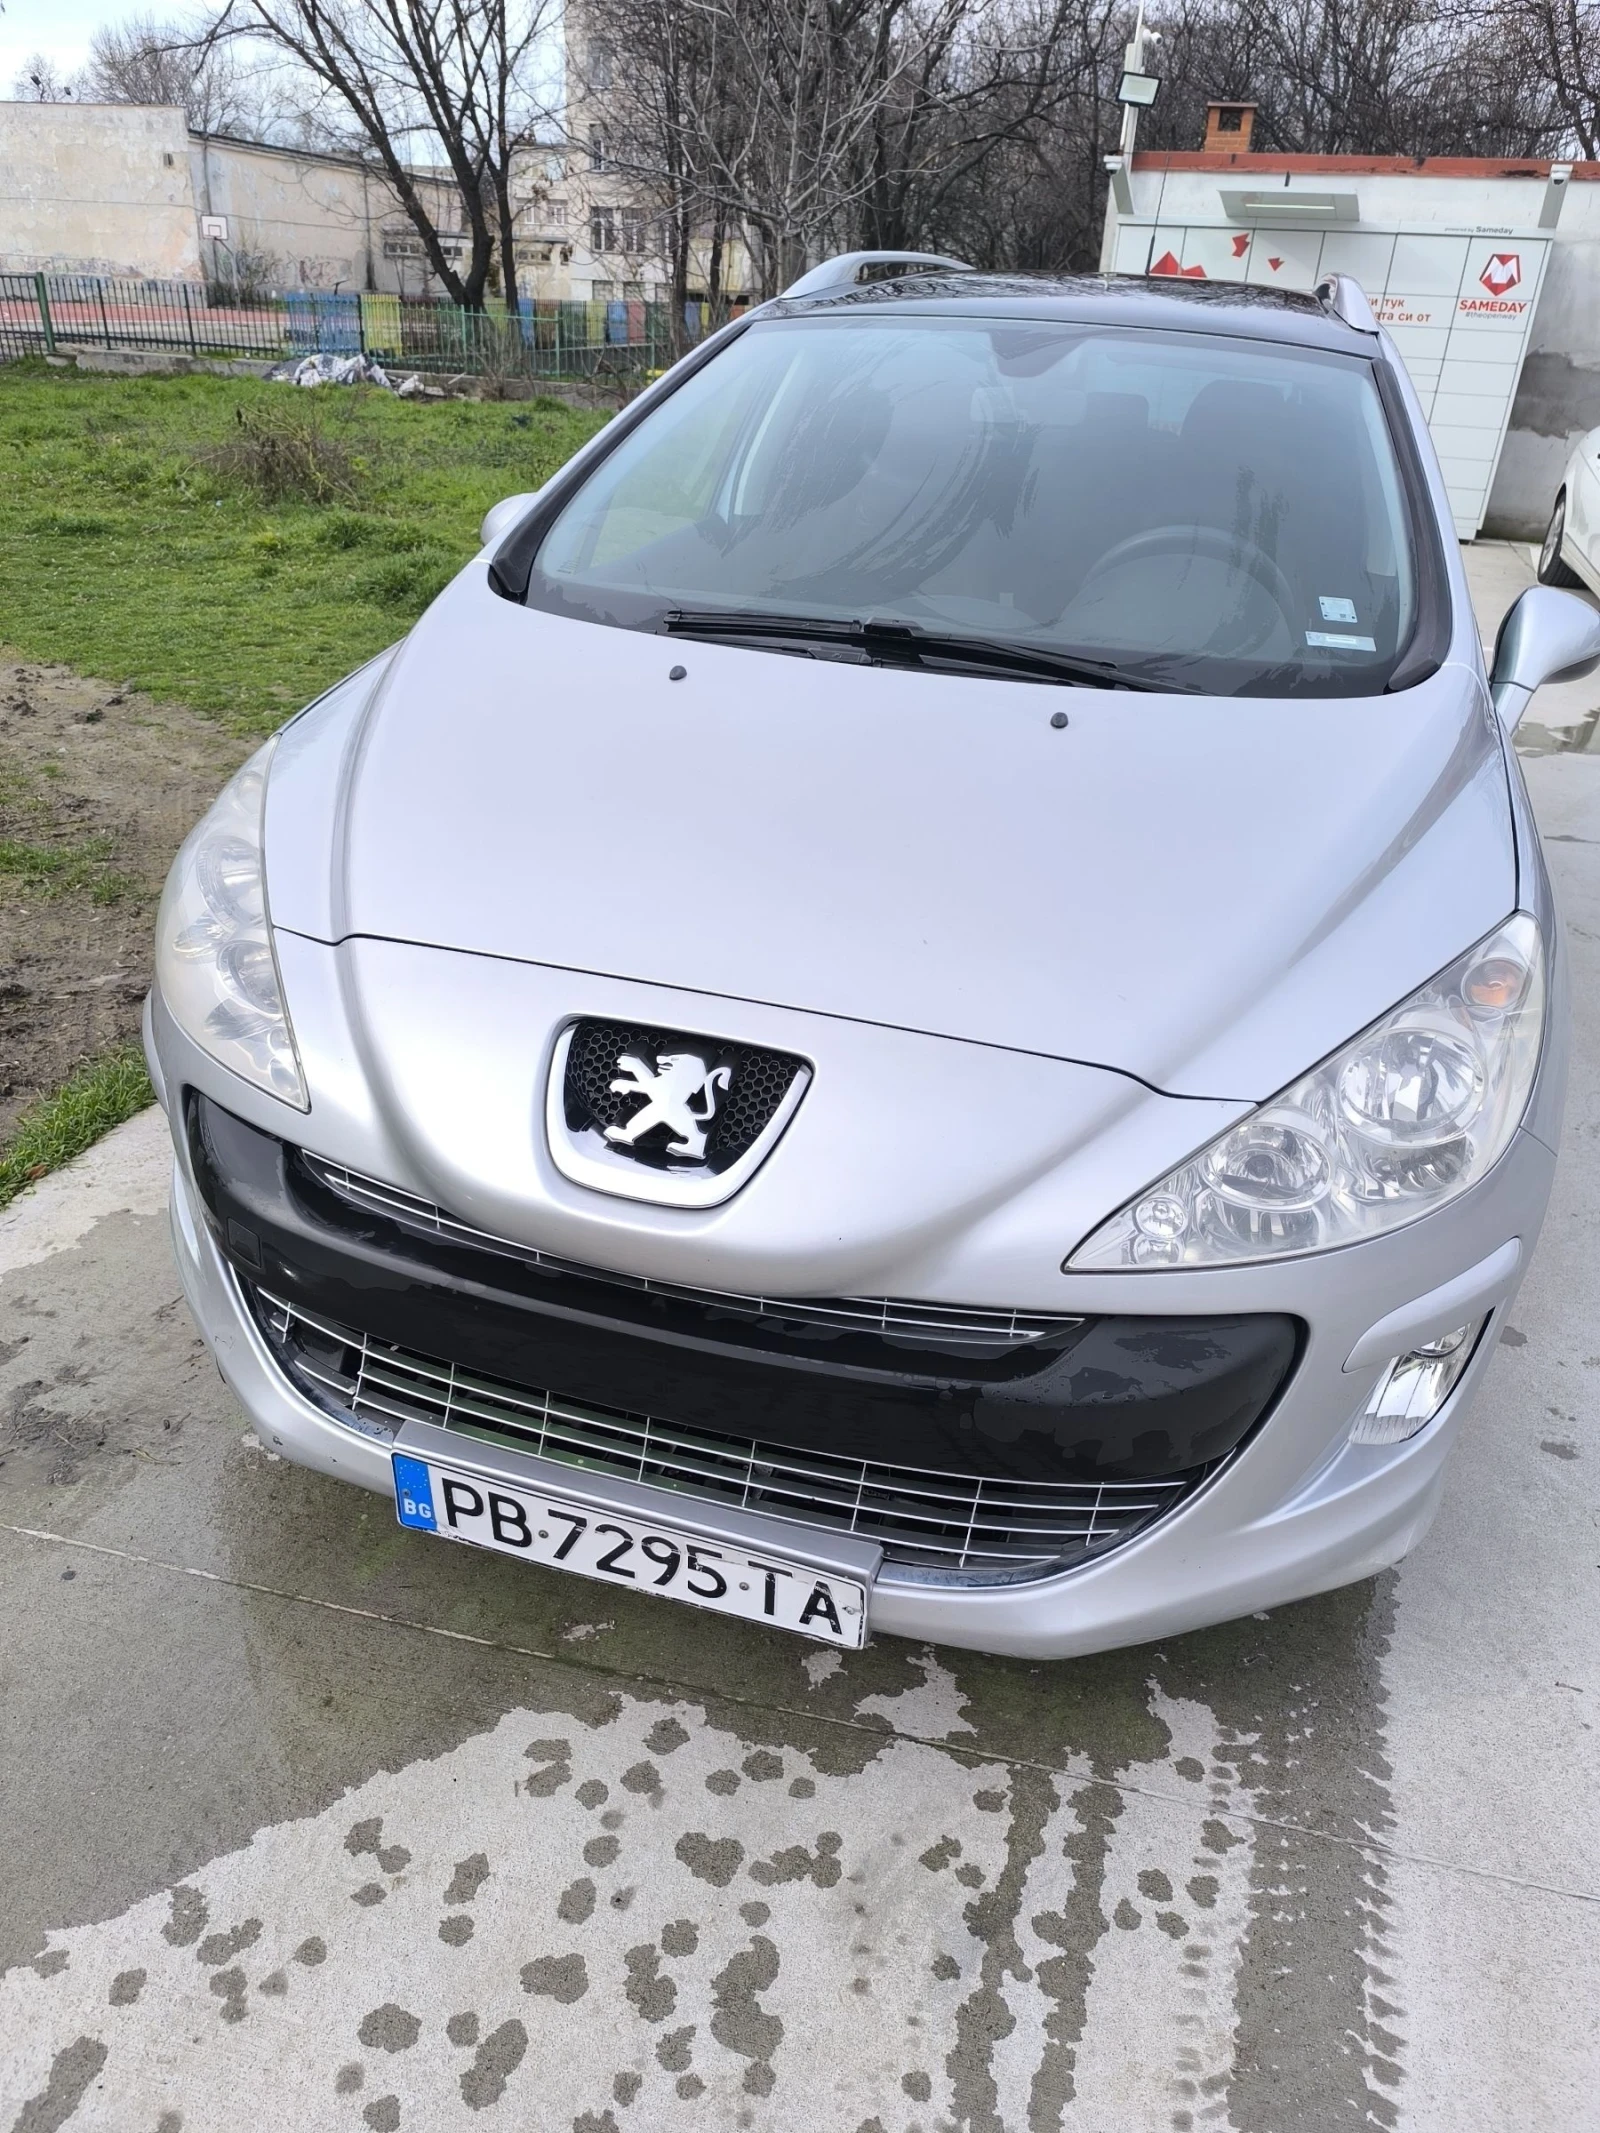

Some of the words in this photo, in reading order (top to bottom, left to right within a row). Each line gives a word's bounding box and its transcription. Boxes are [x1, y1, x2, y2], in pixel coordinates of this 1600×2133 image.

[1475, 226, 1514, 235] Sameday
[1384, 298, 1405, 309] тук
[1459, 299, 1527, 313] SAMEDAY
[1398, 312, 1413, 321] си
[1417, 313, 1431, 322] от
[1465, 311, 1518, 321] #theopenway
[403, 1498, 431, 1519] BG
[441, 1477, 533, 1548] PB
[547, 1507, 728, 1600] 7295
[747, 1560, 843, 1635] TA
